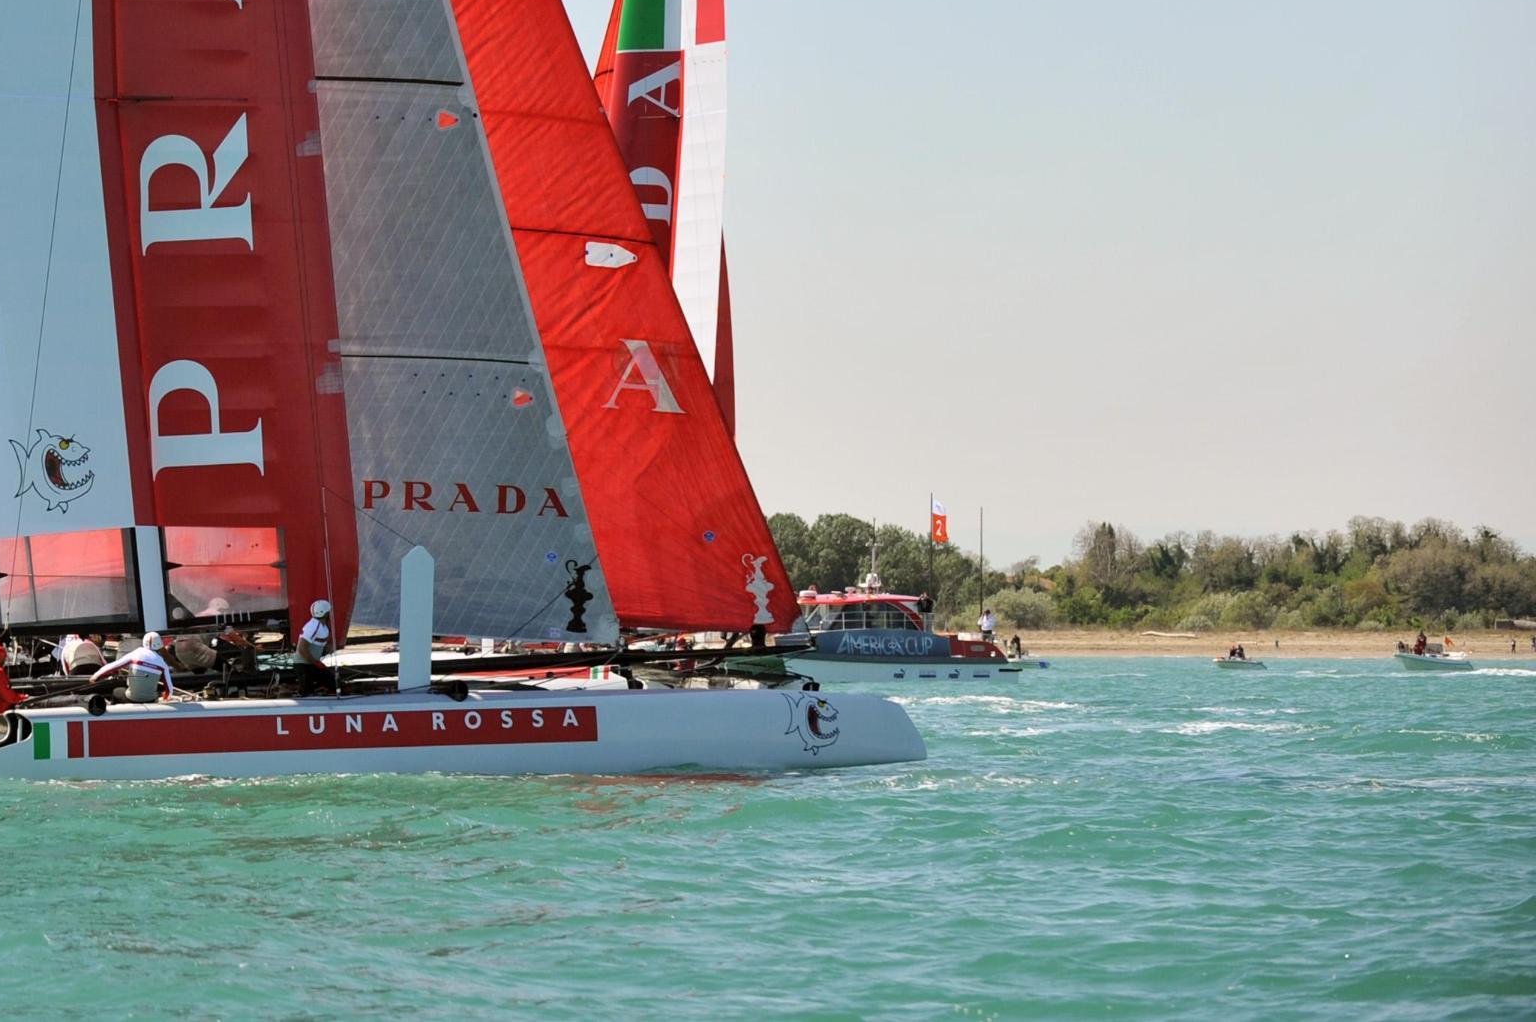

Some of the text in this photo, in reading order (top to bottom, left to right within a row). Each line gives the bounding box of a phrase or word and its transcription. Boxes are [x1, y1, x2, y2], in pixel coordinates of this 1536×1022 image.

[362, 479, 569, 518] PRADA
[936, 519, 942, 536] 2
[905, 636, 933, 655] CUP
[276, 708, 579, 736] LUNA ROSSA
